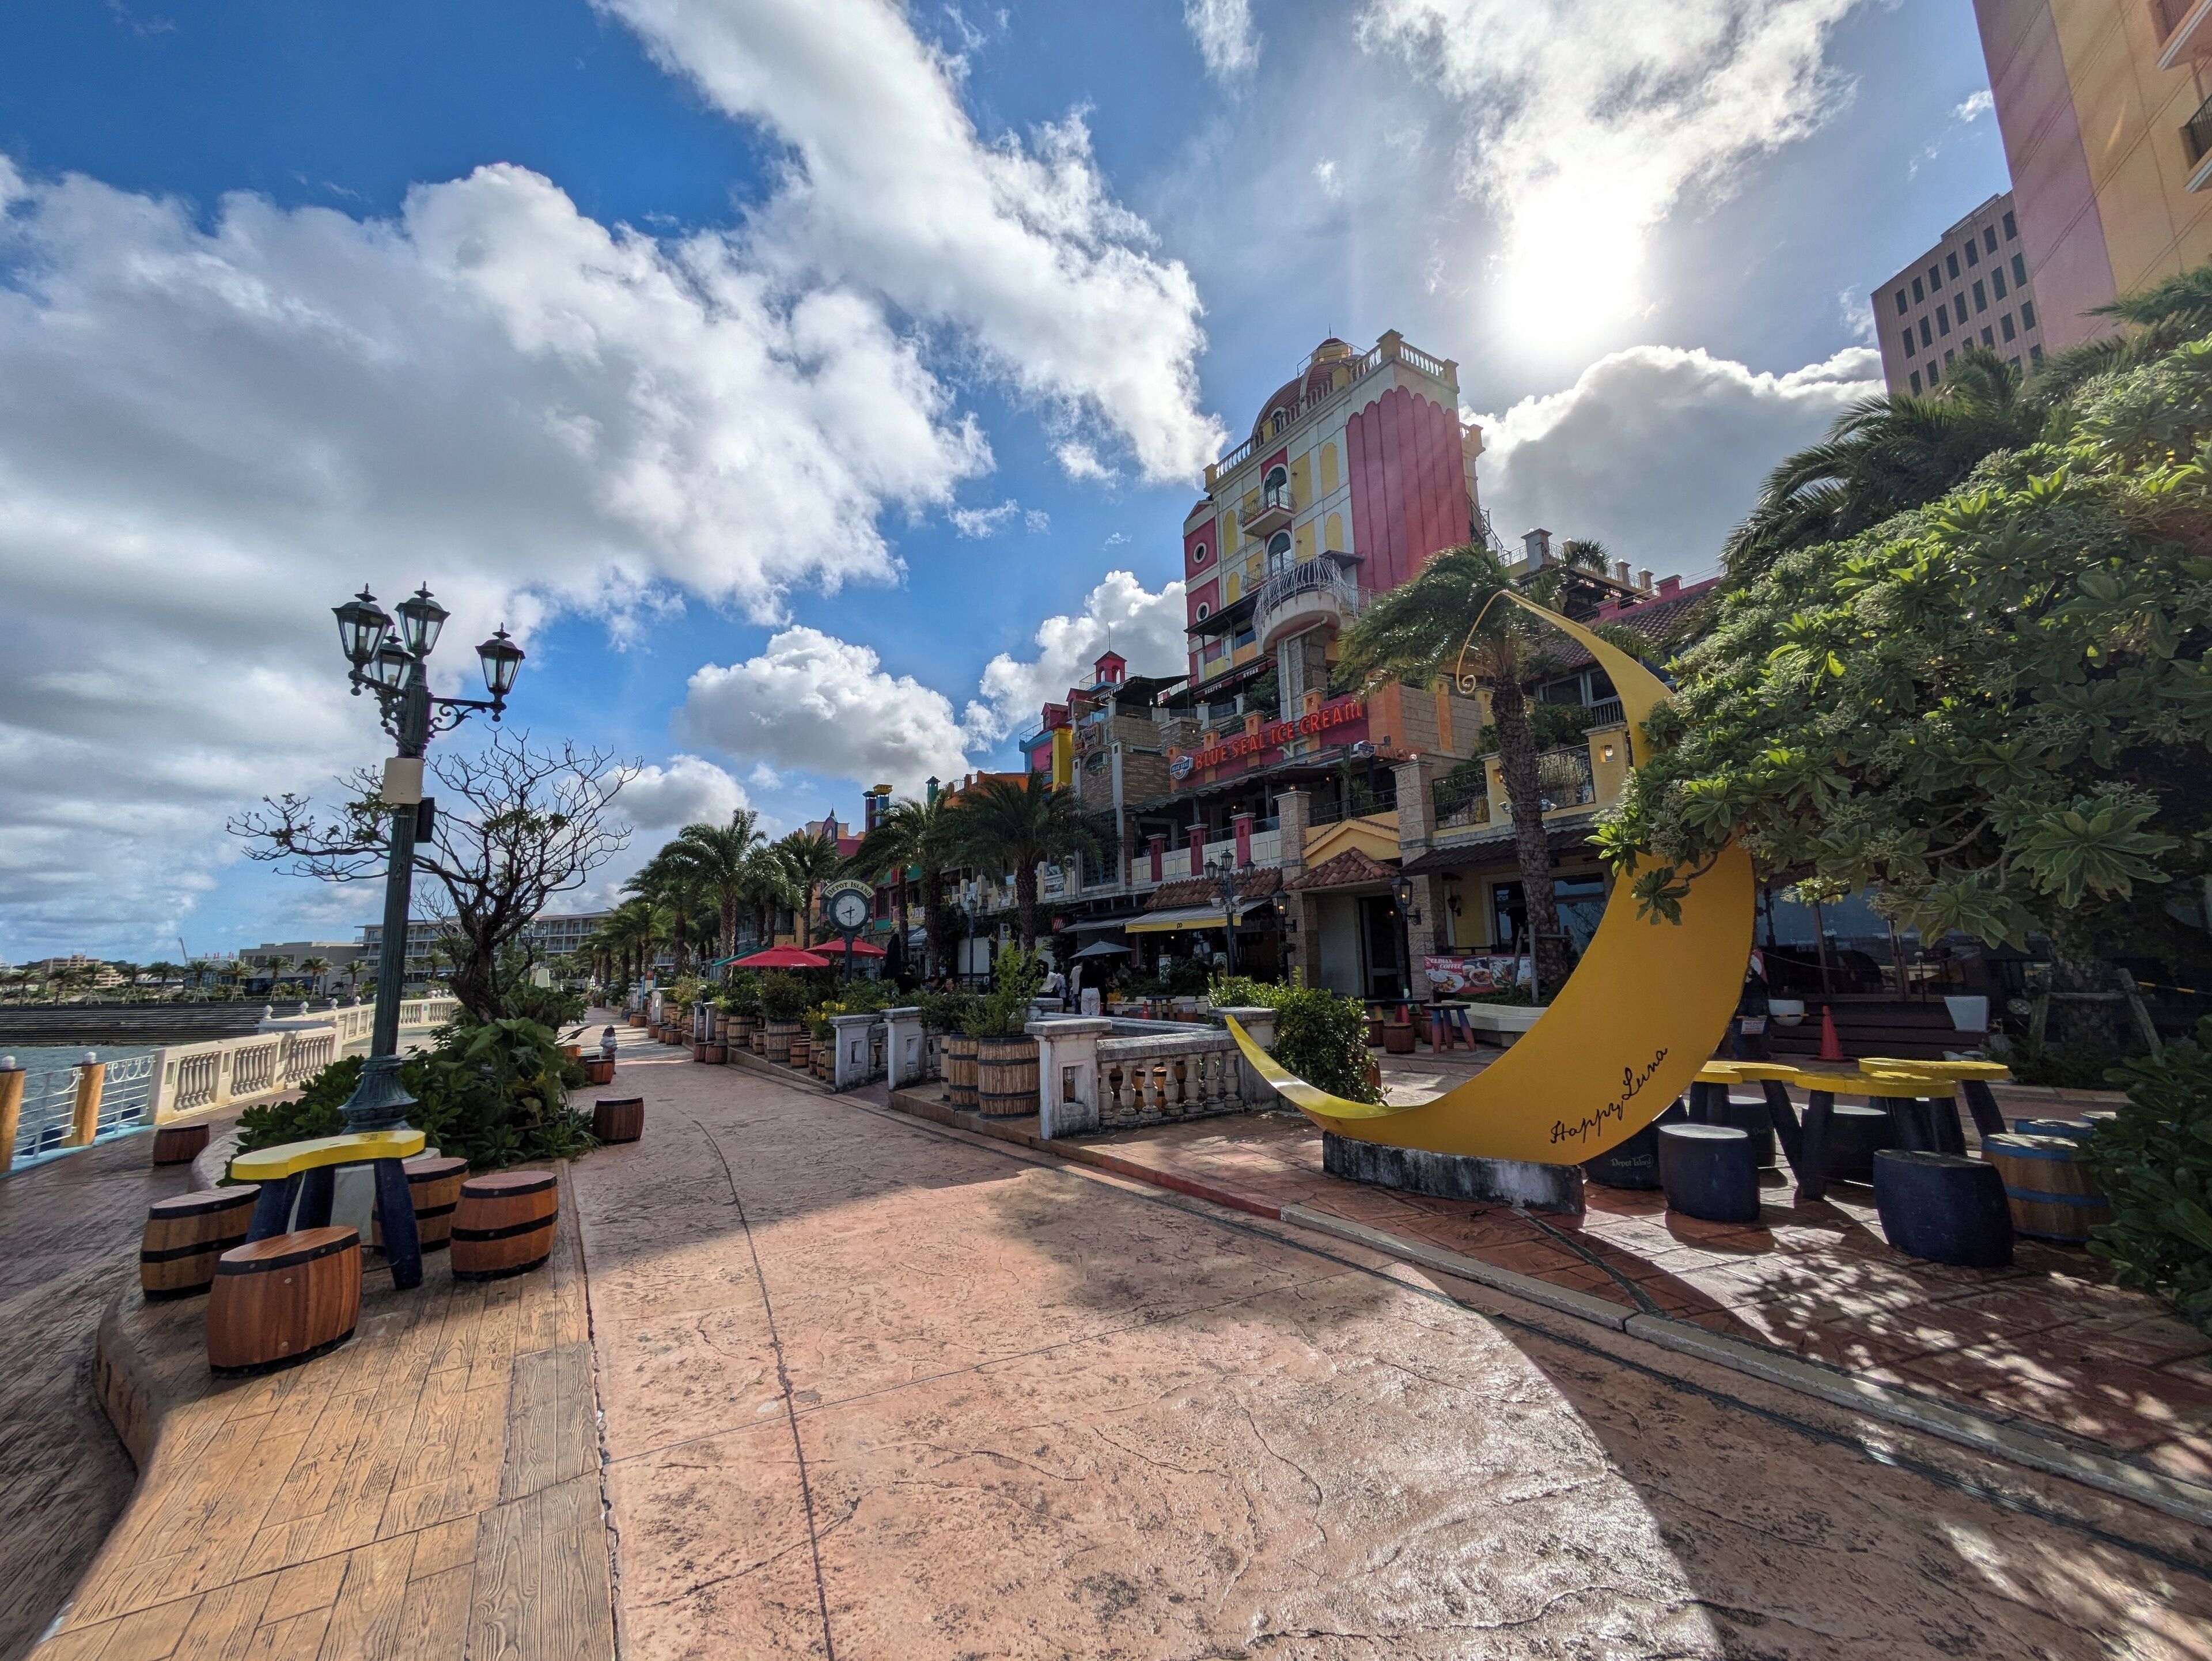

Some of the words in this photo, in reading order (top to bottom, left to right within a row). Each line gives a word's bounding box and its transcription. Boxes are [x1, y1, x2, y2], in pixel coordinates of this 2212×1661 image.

[1243, 668, 1259, 678] STEAK
[1195, 745, 1227, 770] BLUE
[1232, 733, 1266, 758] SEAL
[1271, 721, 1296, 744] ICE
[1299, 701, 1363, 735] CREAM
[827, 882, 848, 896] DEPOT
[850, 881, 872, 897] ISLAND
[1550, 1099, 1623, 1143] Happy
[1622, 1047, 1668, 1100] Luna
[1611, 1157, 1631, 1167] Depot
